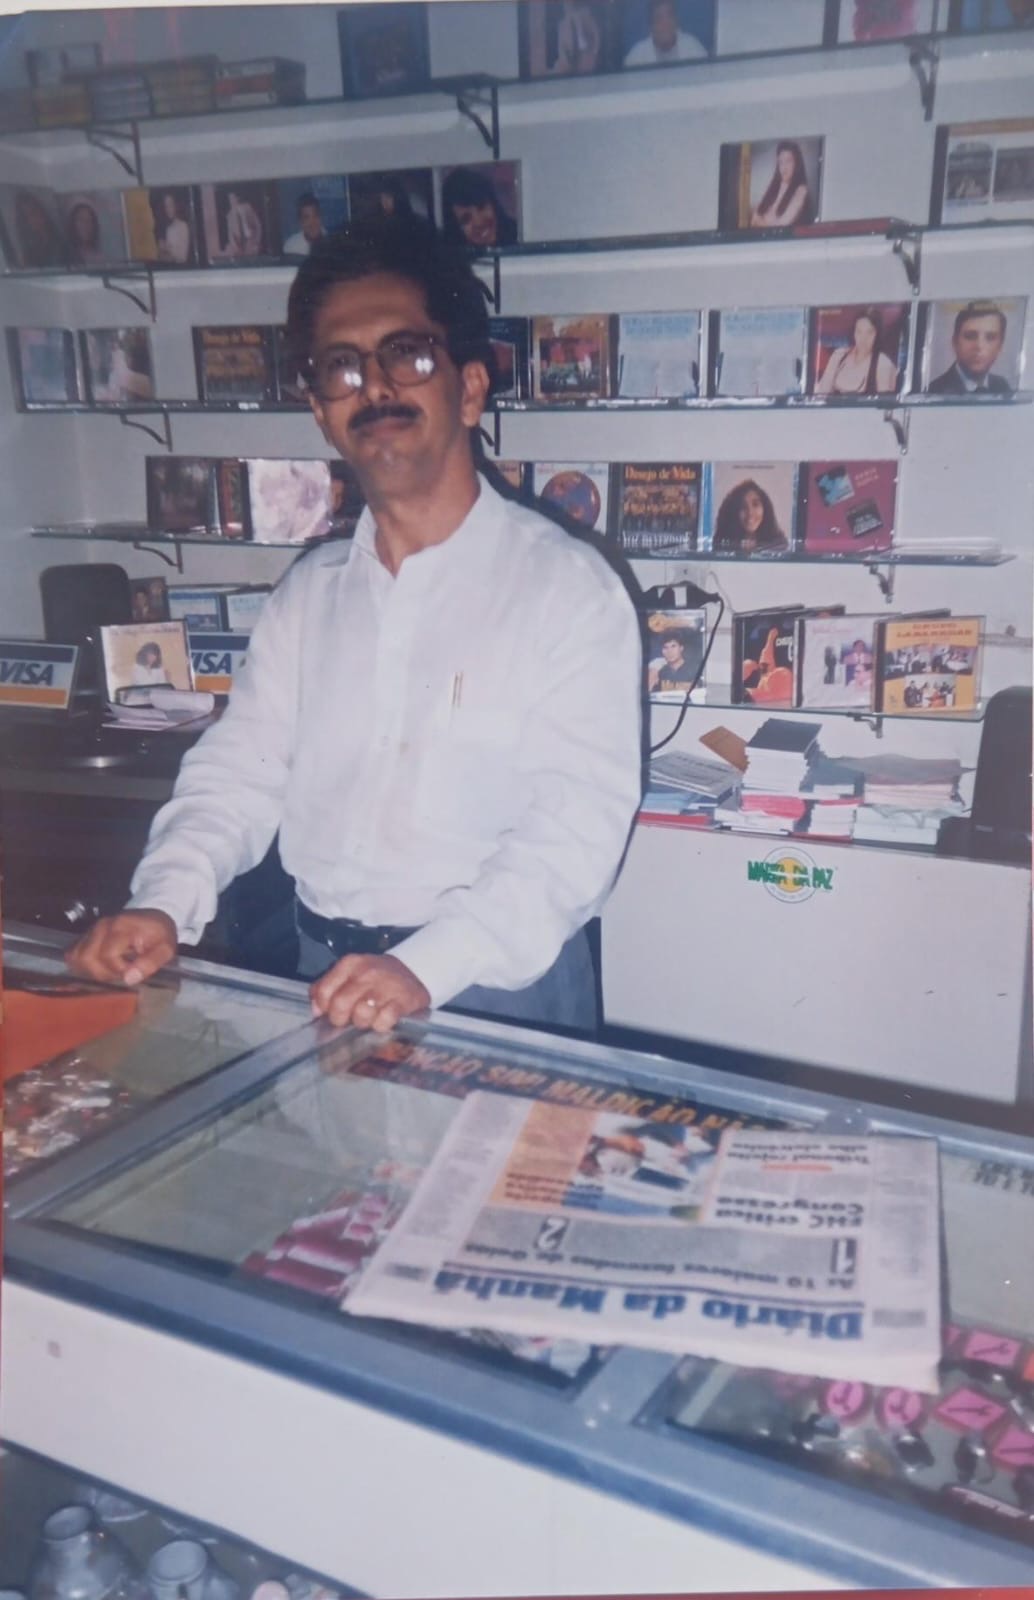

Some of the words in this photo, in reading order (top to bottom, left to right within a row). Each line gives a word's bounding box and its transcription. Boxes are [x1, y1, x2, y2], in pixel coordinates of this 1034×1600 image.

[0, 662, 54, 687] VISA
[716, 1196, 865, 1216] Congresso
[537, 1216, 569, 1250] 2
[809, 1213, 863, 1229] FHC
[786, 1276, 816, 1291] 10
[622, 1291, 687, 1320] da
[701, 1298, 864, 1341] Diário
